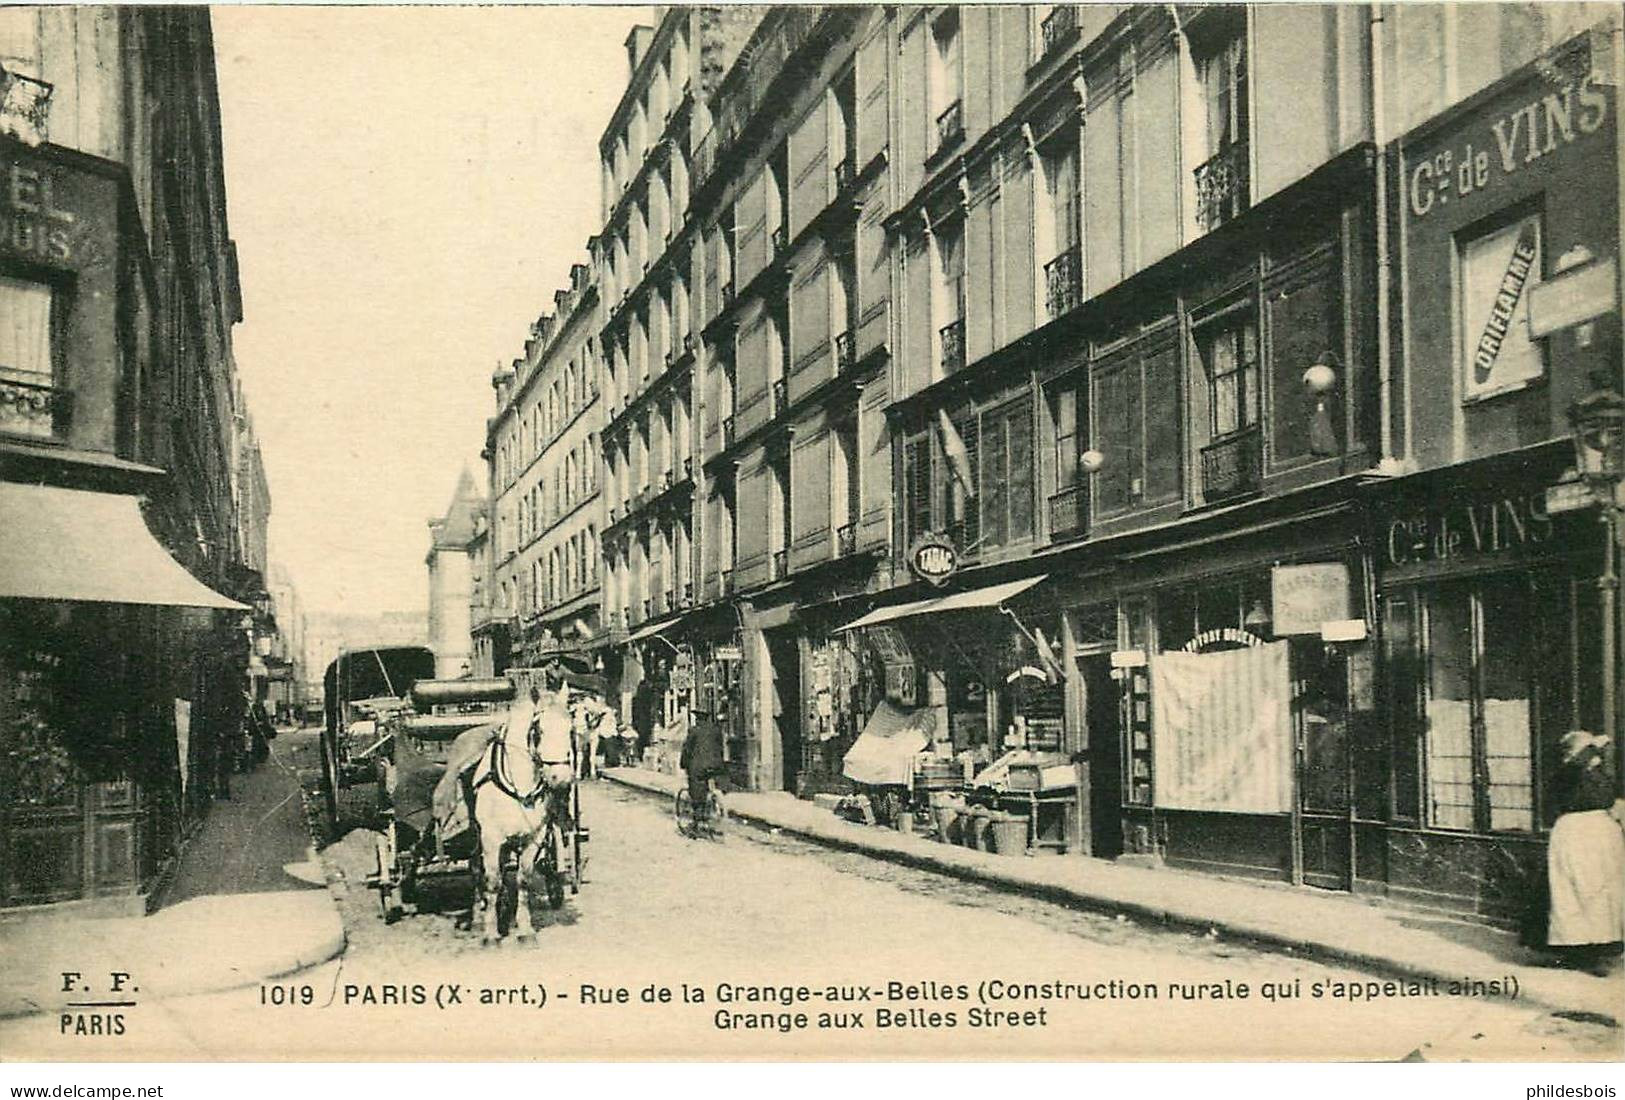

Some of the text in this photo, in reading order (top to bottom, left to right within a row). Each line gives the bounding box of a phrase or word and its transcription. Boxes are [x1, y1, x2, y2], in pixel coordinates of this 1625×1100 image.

[1458, 143, 1489, 197] de
[1492, 81, 1607, 173] VINS
[1475, 242, 1537, 371] ORIFLAMME
[1434, 516, 1461, 560] de
